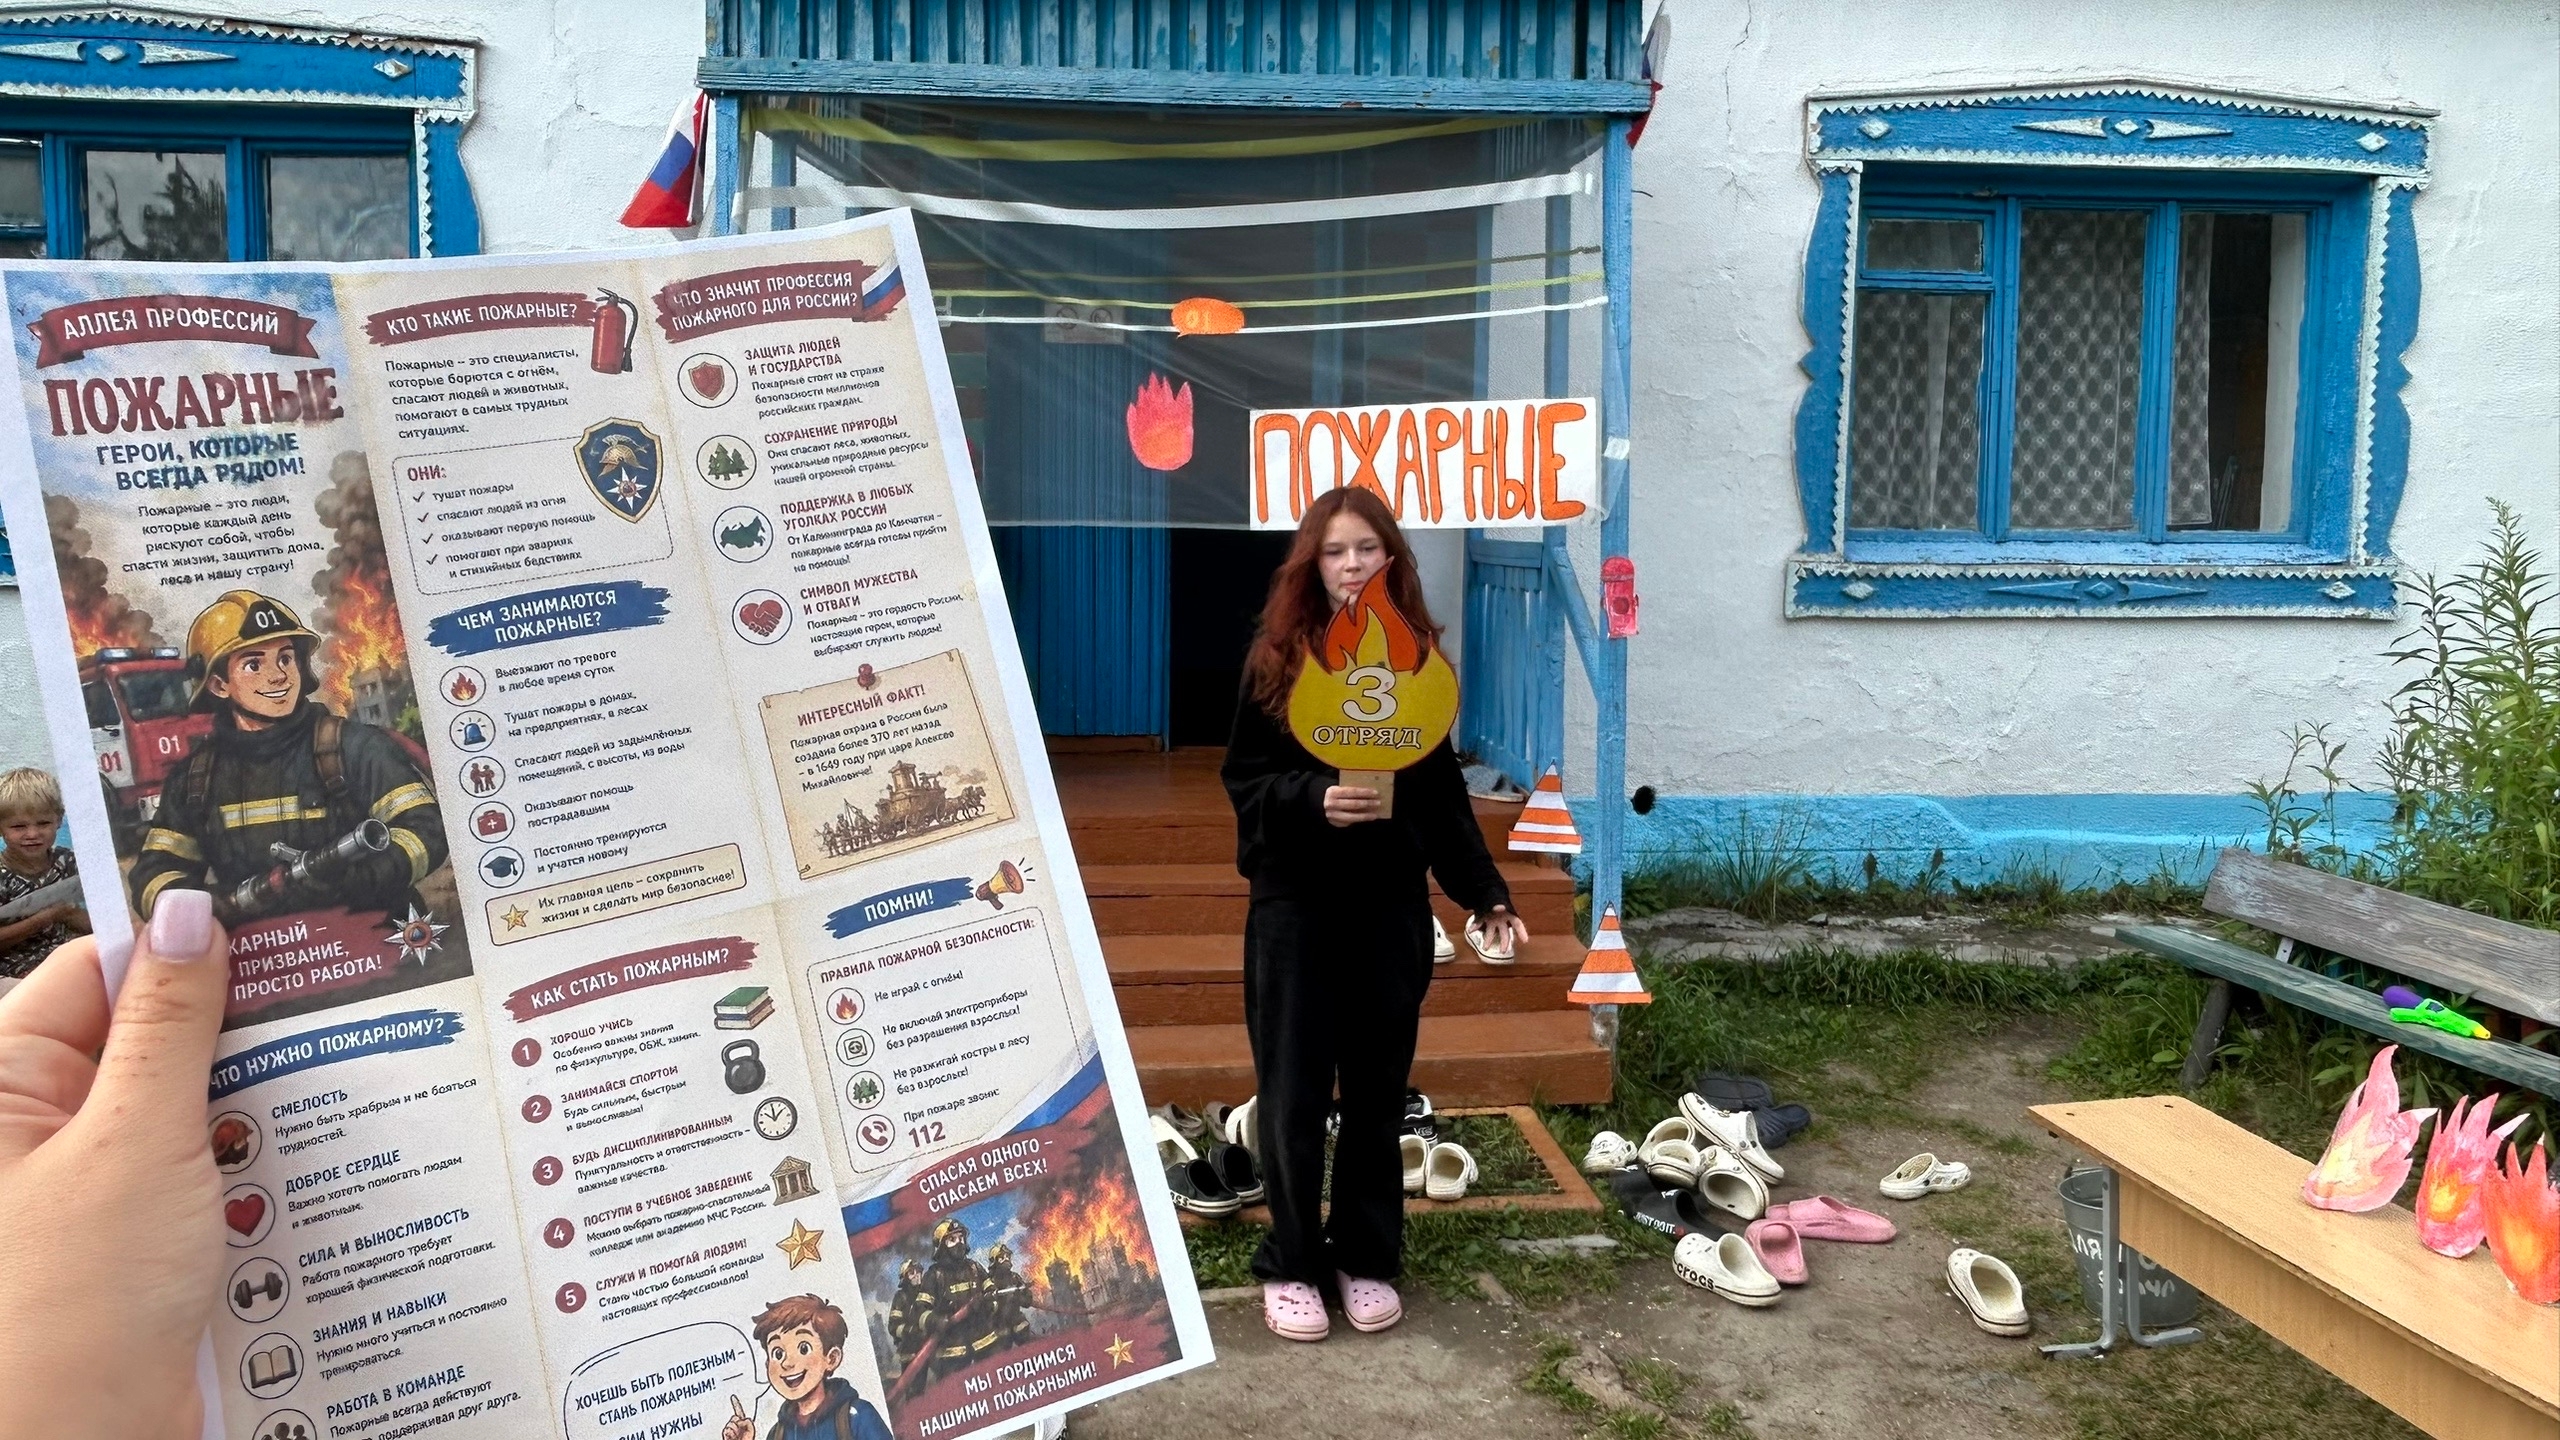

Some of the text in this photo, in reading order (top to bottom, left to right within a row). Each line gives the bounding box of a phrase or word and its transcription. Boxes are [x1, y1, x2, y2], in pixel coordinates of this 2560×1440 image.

[673, 272, 852, 307] ЧТО ЗНАЧИТ ПРОФЕССИЯ
[64, 306, 278, 339] АЛЛЕЯ ПРОФЕССИЙ
[386, 302, 577, 335] КТО ТАКИЕ ПОЖАРНЫЕ?
[672, 292, 857, 330] ПОЖАРНОГО ДЛЯ РОССИИ?
[385, 348, 578, 372] Пожарные это специалисты,
[744, 336, 840, 360] ЗАЩИТА ЛЮДЕЙ
[748, 353, 841, 376] И ГОСУДАРСТВА
[388, 376, 444, 389] которые
[447, 371, 503, 385] борются
[506, 370, 514, 378] с
[391, 393, 444, 405] спасают
[448, 386, 489, 400] людей
[492, 388, 500, 396] и
[43, 367, 344, 436] ПОЖАРНЫЕ
[395, 397, 568, 421] помогают в самых трудных
[764, 414, 897, 444] СОХРАНЕНИЕ ПРИРОДЫ
[95, 432, 299, 465] ГЕРОИ, КОТОРЫЕ
[1254, 402, 1586, 523] ПОЖАРНЫЕ
[115, 456, 490, 490] ВСЕГДА РЯДОМ!
[407, 464, 446, 481] ОНИ:
[780, 482, 913, 514] ПОДДЕРЖКА В ЛЮБЫХ
[782, 503, 886, 530] УГОЛКАХ РОССИИ
[799, 568, 918, 599] СИМВОЛ МУЖЕСТВА
[256, 607, 280, 630] 01
[457, 590, 616, 630] ЧЕМ ЗАНИМАЮТСЯ
[803, 595, 860, 615] И ОТВАГИ
[494, 610, 601, 642] ПОЖАРНЫЕ?
[495, 650, 616, 678] Выезжают по тревоге
[503, 709, 539, 723] Тушат
[542, 700, 586, 715] пожары
[588, 698, 596, 706] в
[797, 683, 925, 726] ИНТЕРЕСНЫЙ ФАКТ!
[1342, 666, 1398, 722] 3
[159, 735, 180, 754] 01
[794, 719, 941, 763] создана более 370 лет назад
[1312, 725, 1422, 750] ОТРЯД
[102, 750, 122, 772] 01
[524, 784, 634, 812] Оказывают помощь
[533, 822, 666, 858] Постоянно тренируются
[864, 888, 933, 921] ПОМНИ!
[238, 941, 350, 978] ПРИЗВАНИЕ,
[820, 918, 1034, 983] ПРАВИЛА ПОЖАРНОЙ БЕЗОПАСНОСТИ:
[235, 954, 381, 1000] ПРОСТО РАБОТА!
[530, 947, 728, 1008] КАК СТАТЬ ПОЖАРНЫМ?
[874, 991, 888, 1002] Не
[890, 981, 920, 997] играй
[245, 1042, 312, 1076] НУЖНО
[319, 1017, 445, 1054] ПОЖАРНОМУ?
[550, 1018, 633, 1045] ХОРОШО УЧИСЬ
[522, 1045, 530, 1060] 1
[560, 1065, 678, 1103] ЗАНИМАЙСЯ СПОРТОМ
[271, 1089, 347, 1119] СМЕЛОСТЬ
[532, 1102, 542, 1116] 2
[572, 1114, 732, 1165] БУДЬ ДИСЦИПЛИНИРОВАННЫМ
[908, 1121, 946, 1147] 112
[285, 1149, 400, 1196] ДОБРОЕ СЕРДЦЕ
[542, 1164, 553, 1178] 3
[918, 1138, 1040, 1194] СПАСАЯ ОДНОГО
[583, 1171, 752, 1227] ПОСТУПИ В УЧЕБНОЕ ЗАВЕДЕНИЕ
[928, 1158, 1048, 1213] СПАСАЕМ ВСЕХ!
[298, 1207, 469, 1267] СИЛА И ВЫНОСЛИВОСТЬ
[552, 1226, 565, 1241] 4
[595, 1238, 746, 1290] СЛУЖИ И ПОМОГАЙ ЛЮДЯМ!
[1676, 1262, 1715, 1290] crocs
[564, 1290, 576, 1306] 5
[313, 1291, 446, 1342] ЗНАНИЯ И НАВЫКИ
[316, 1343, 353, 1361] Нужно
[355, 1333, 388, 1349] много
[437, 1316, 446, 1324] и
[448, 1297, 507, 1321] постоянно
[574, 1349, 736, 1410] ХОЧЕШЬ БЫТЬ ПОЛЕЗНЫМ
[964, 1343, 1076, 1395] МЫ ГОРДИМСЯ
[326, 1365, 465, 1419] РАБОТА В КОМАНДЕ
[598, 1377, 716, 1425] СТАНЬ ПОЖАРНЫМ!
[919, 1360, 1096, 1437] НАШИМИ ПОЖАРНЫМИ!
[650, 1412, 703, 1440] НУЖНЫ
